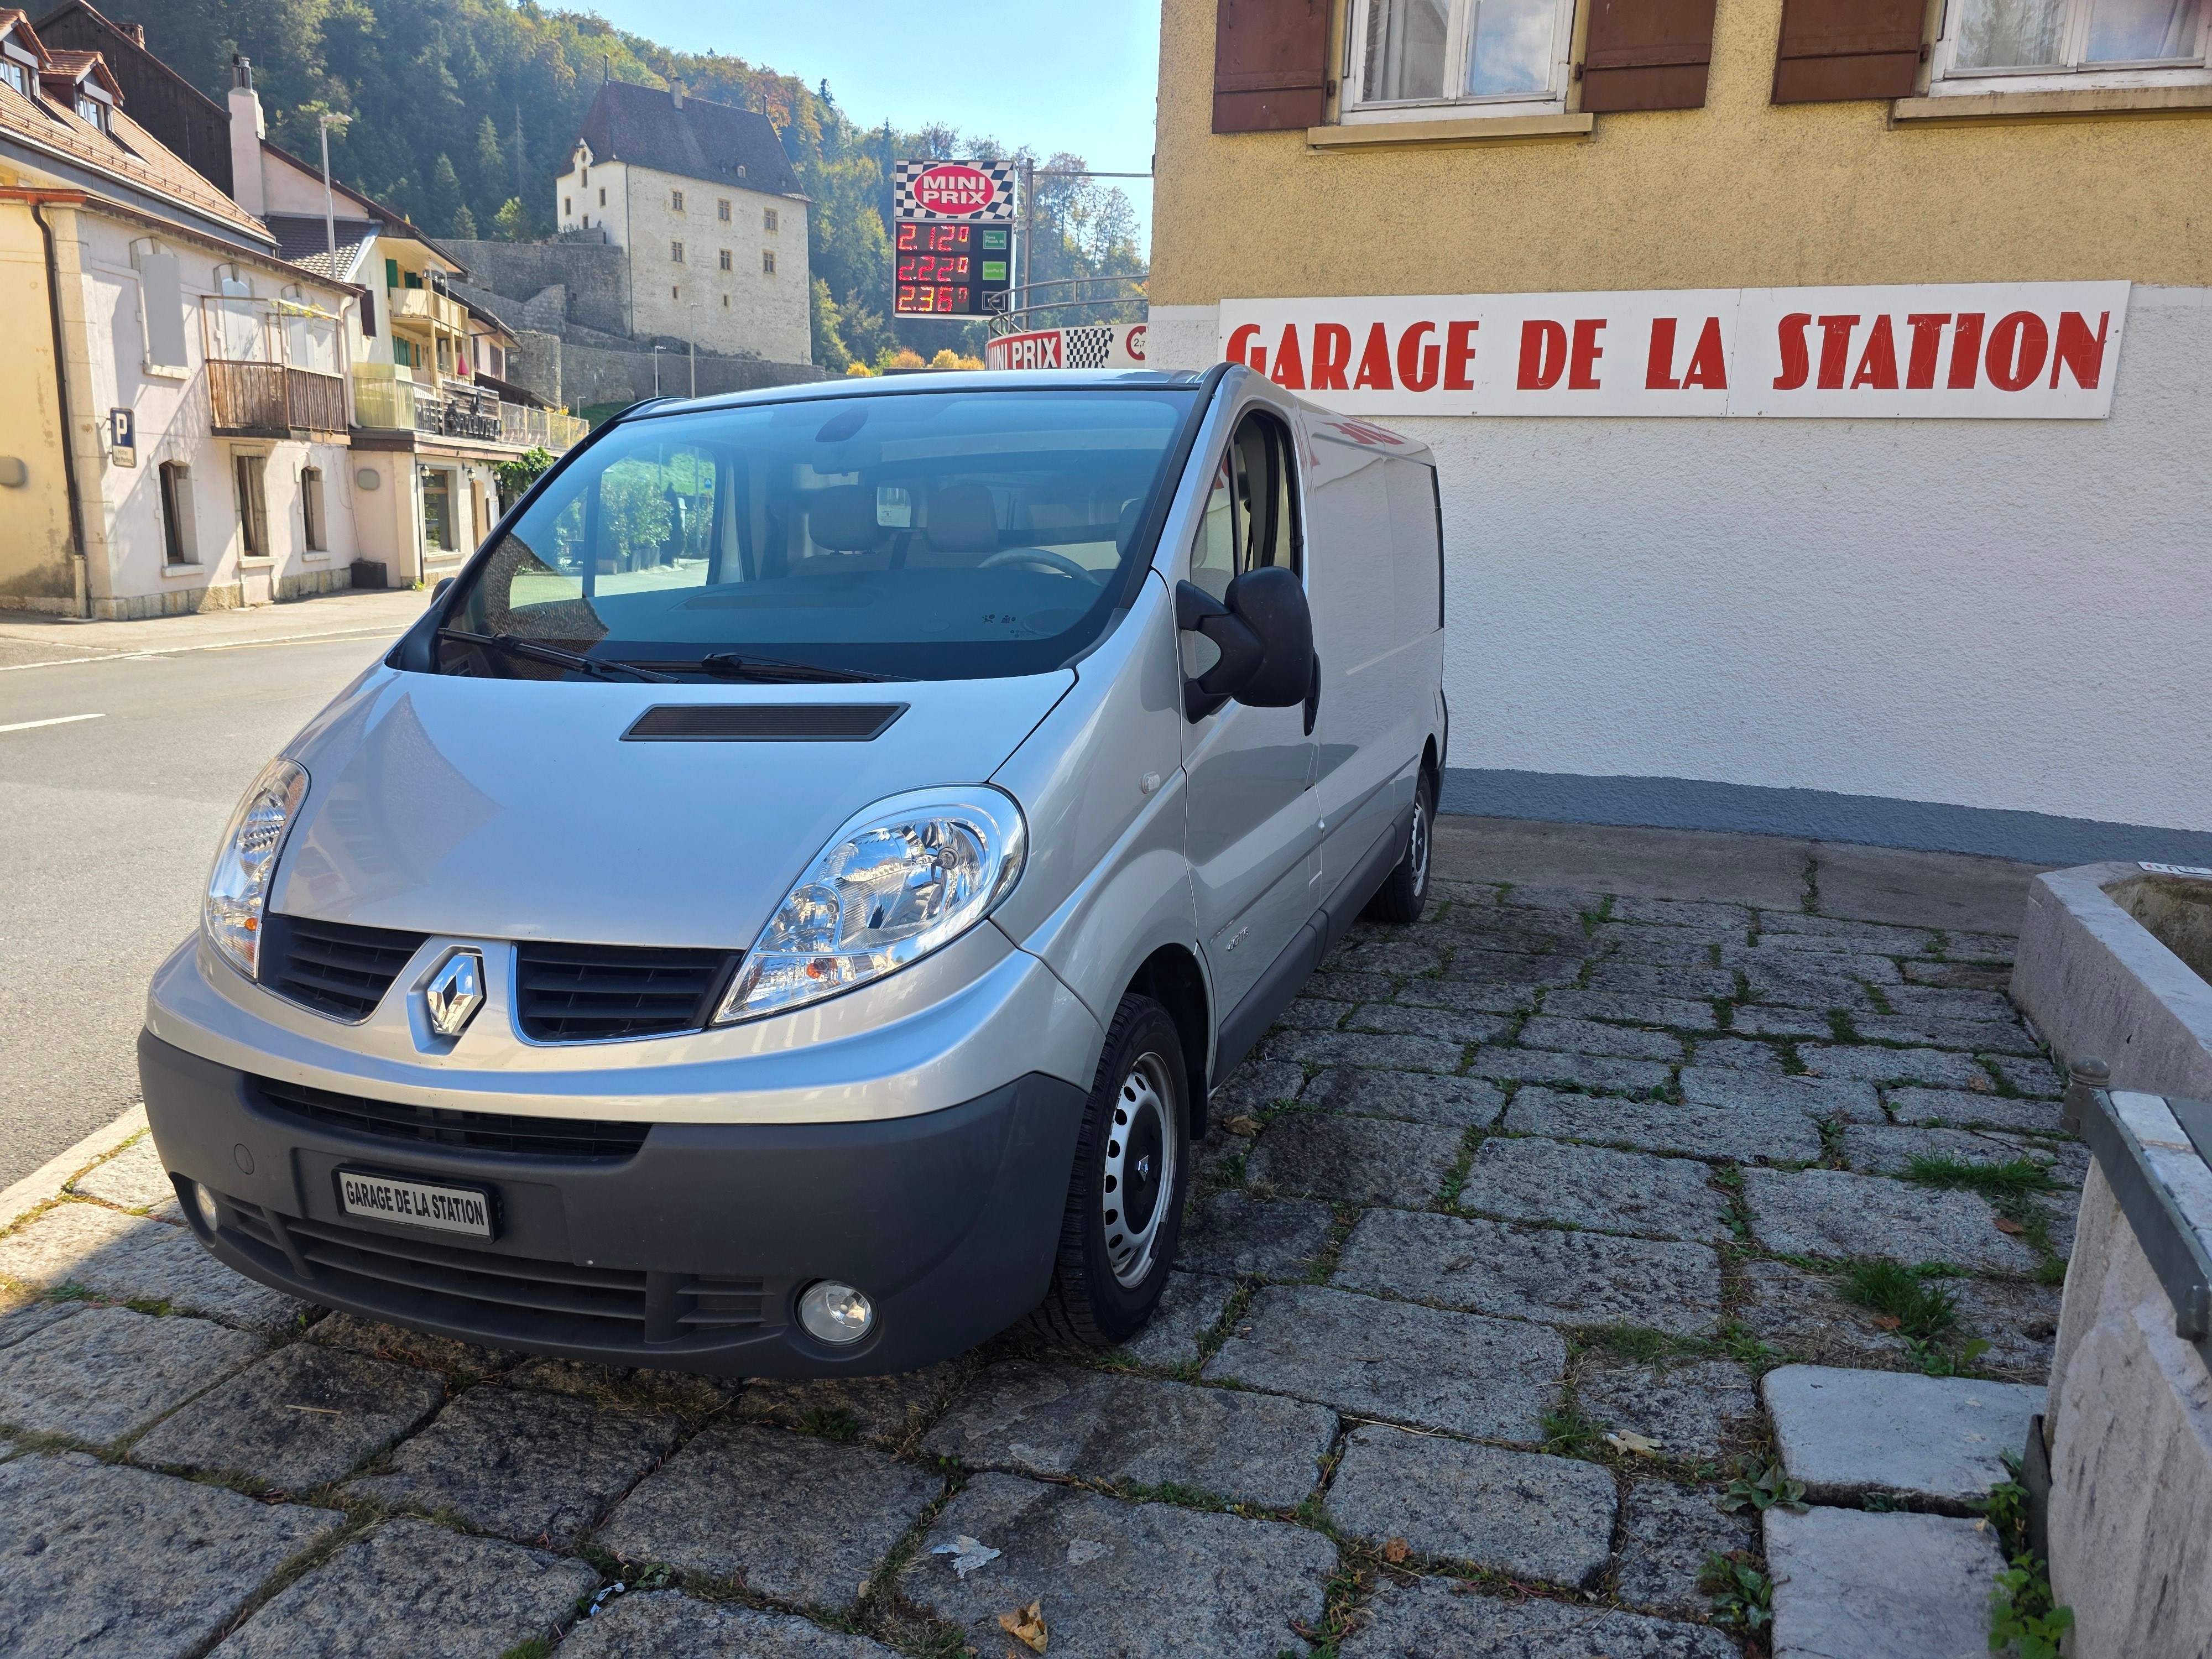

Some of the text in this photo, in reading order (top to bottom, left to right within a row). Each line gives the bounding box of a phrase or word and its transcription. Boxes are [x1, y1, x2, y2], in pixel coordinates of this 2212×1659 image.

[922, 176, 985, 190] MINI
[922, 191, 985, 205] PRIX
[988, 337, 1058, 370] MINI PRIX
[1226, 311, 2109, 392] GARAGE DE LA STATION
[116, 413, 127, 444] P
[346, 1181, 485, 1226] GARAGE DE LA STATION
